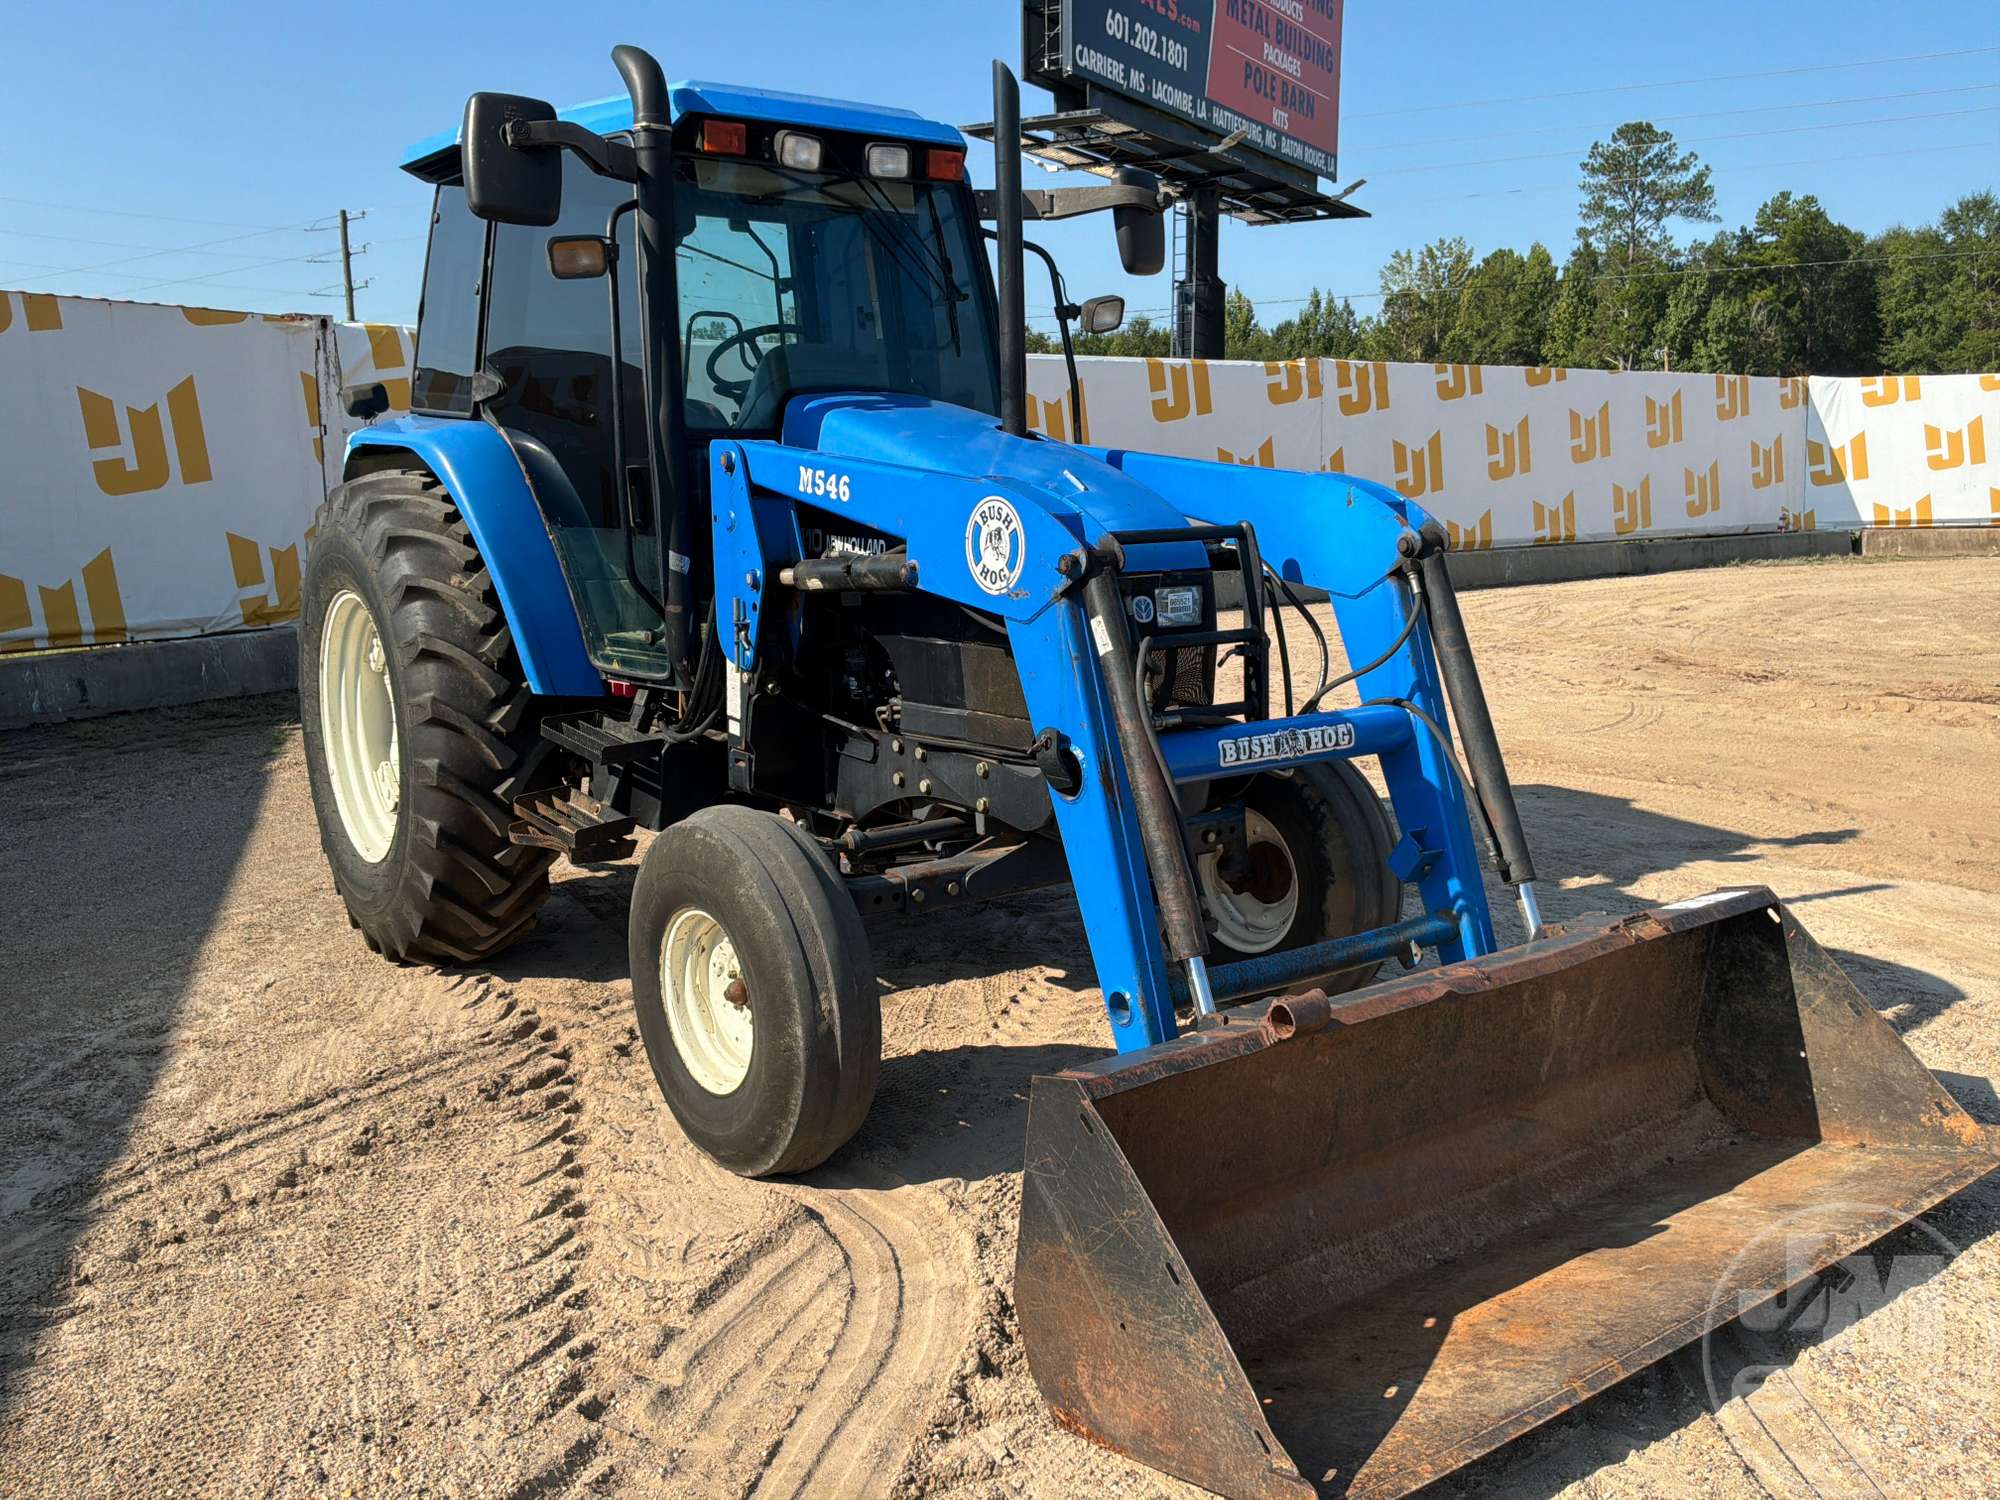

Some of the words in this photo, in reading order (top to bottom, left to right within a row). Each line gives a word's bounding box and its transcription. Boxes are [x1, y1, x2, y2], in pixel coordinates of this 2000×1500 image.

[1105, 8, 1188, 72] 601.202.1801
[1276, 17, 1334, 74] BUILDING
[1263, 42, 1301, 77] PACKAGES
[1075, 44, 1127, 90] CARRIERE,
[1129, 68, 1145, 93] MS
[1152, 79, 1195, 118] LACOMBE,
[1197, 98, 1207, 120] LA
[1265, 129, 1277, 150] MS
[1281, 136, 1303, 161] BATON
[1327, 157, 1336, 175] LA
[1244, 62, 1277, 101] POLE
[1280, 80, 1316, 120] BARN
[1272, 107, 1289, 130] KITS
[798, 465, 850, 502] M546
[979, 505, 1013, 531] BUSH
[979, 563, 1008, 585] HOG
[1222, 734, 1277, 763] BUSH
[1309, 723, 1351, 750] HOG
